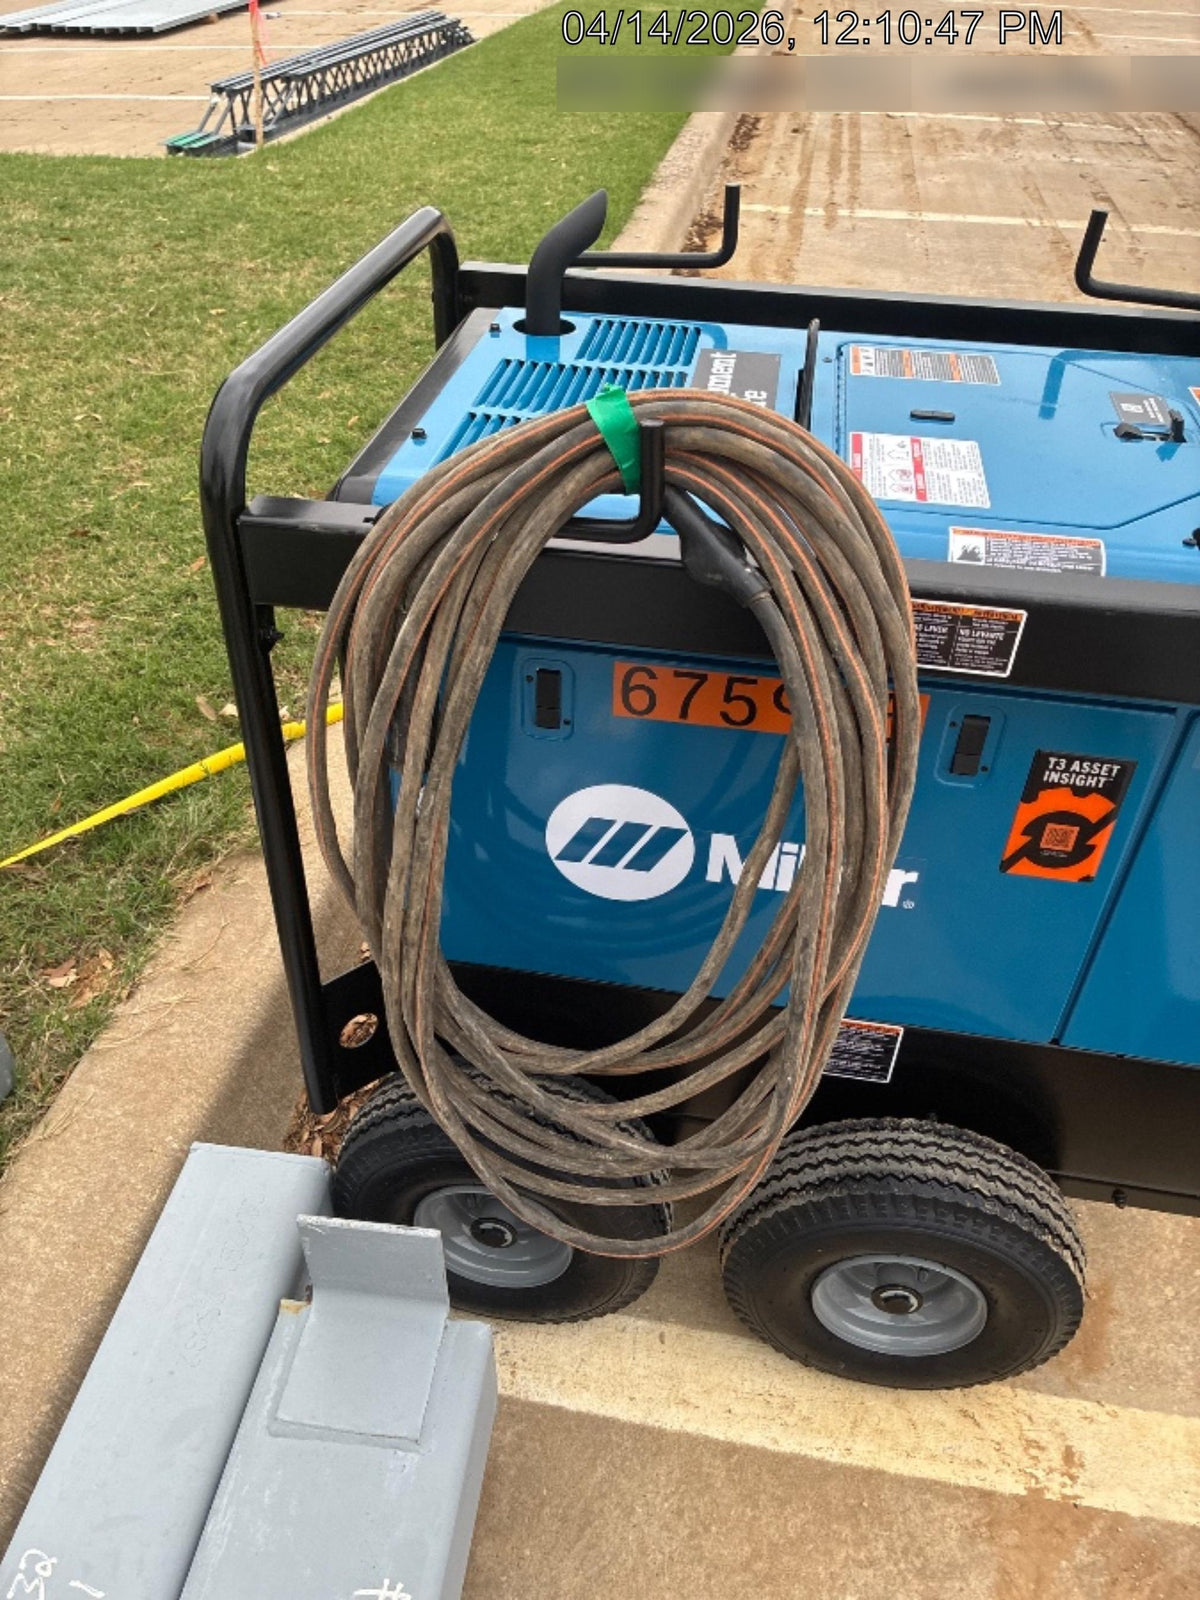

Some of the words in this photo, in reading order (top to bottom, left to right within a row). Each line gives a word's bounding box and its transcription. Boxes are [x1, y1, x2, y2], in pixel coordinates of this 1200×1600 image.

[707, 352, 737, 393] ment
[1048, 757, 1067, 771] T3
[1070, 760, 1121, 777] ASSET
[705, 833, 919, 907] Mir
